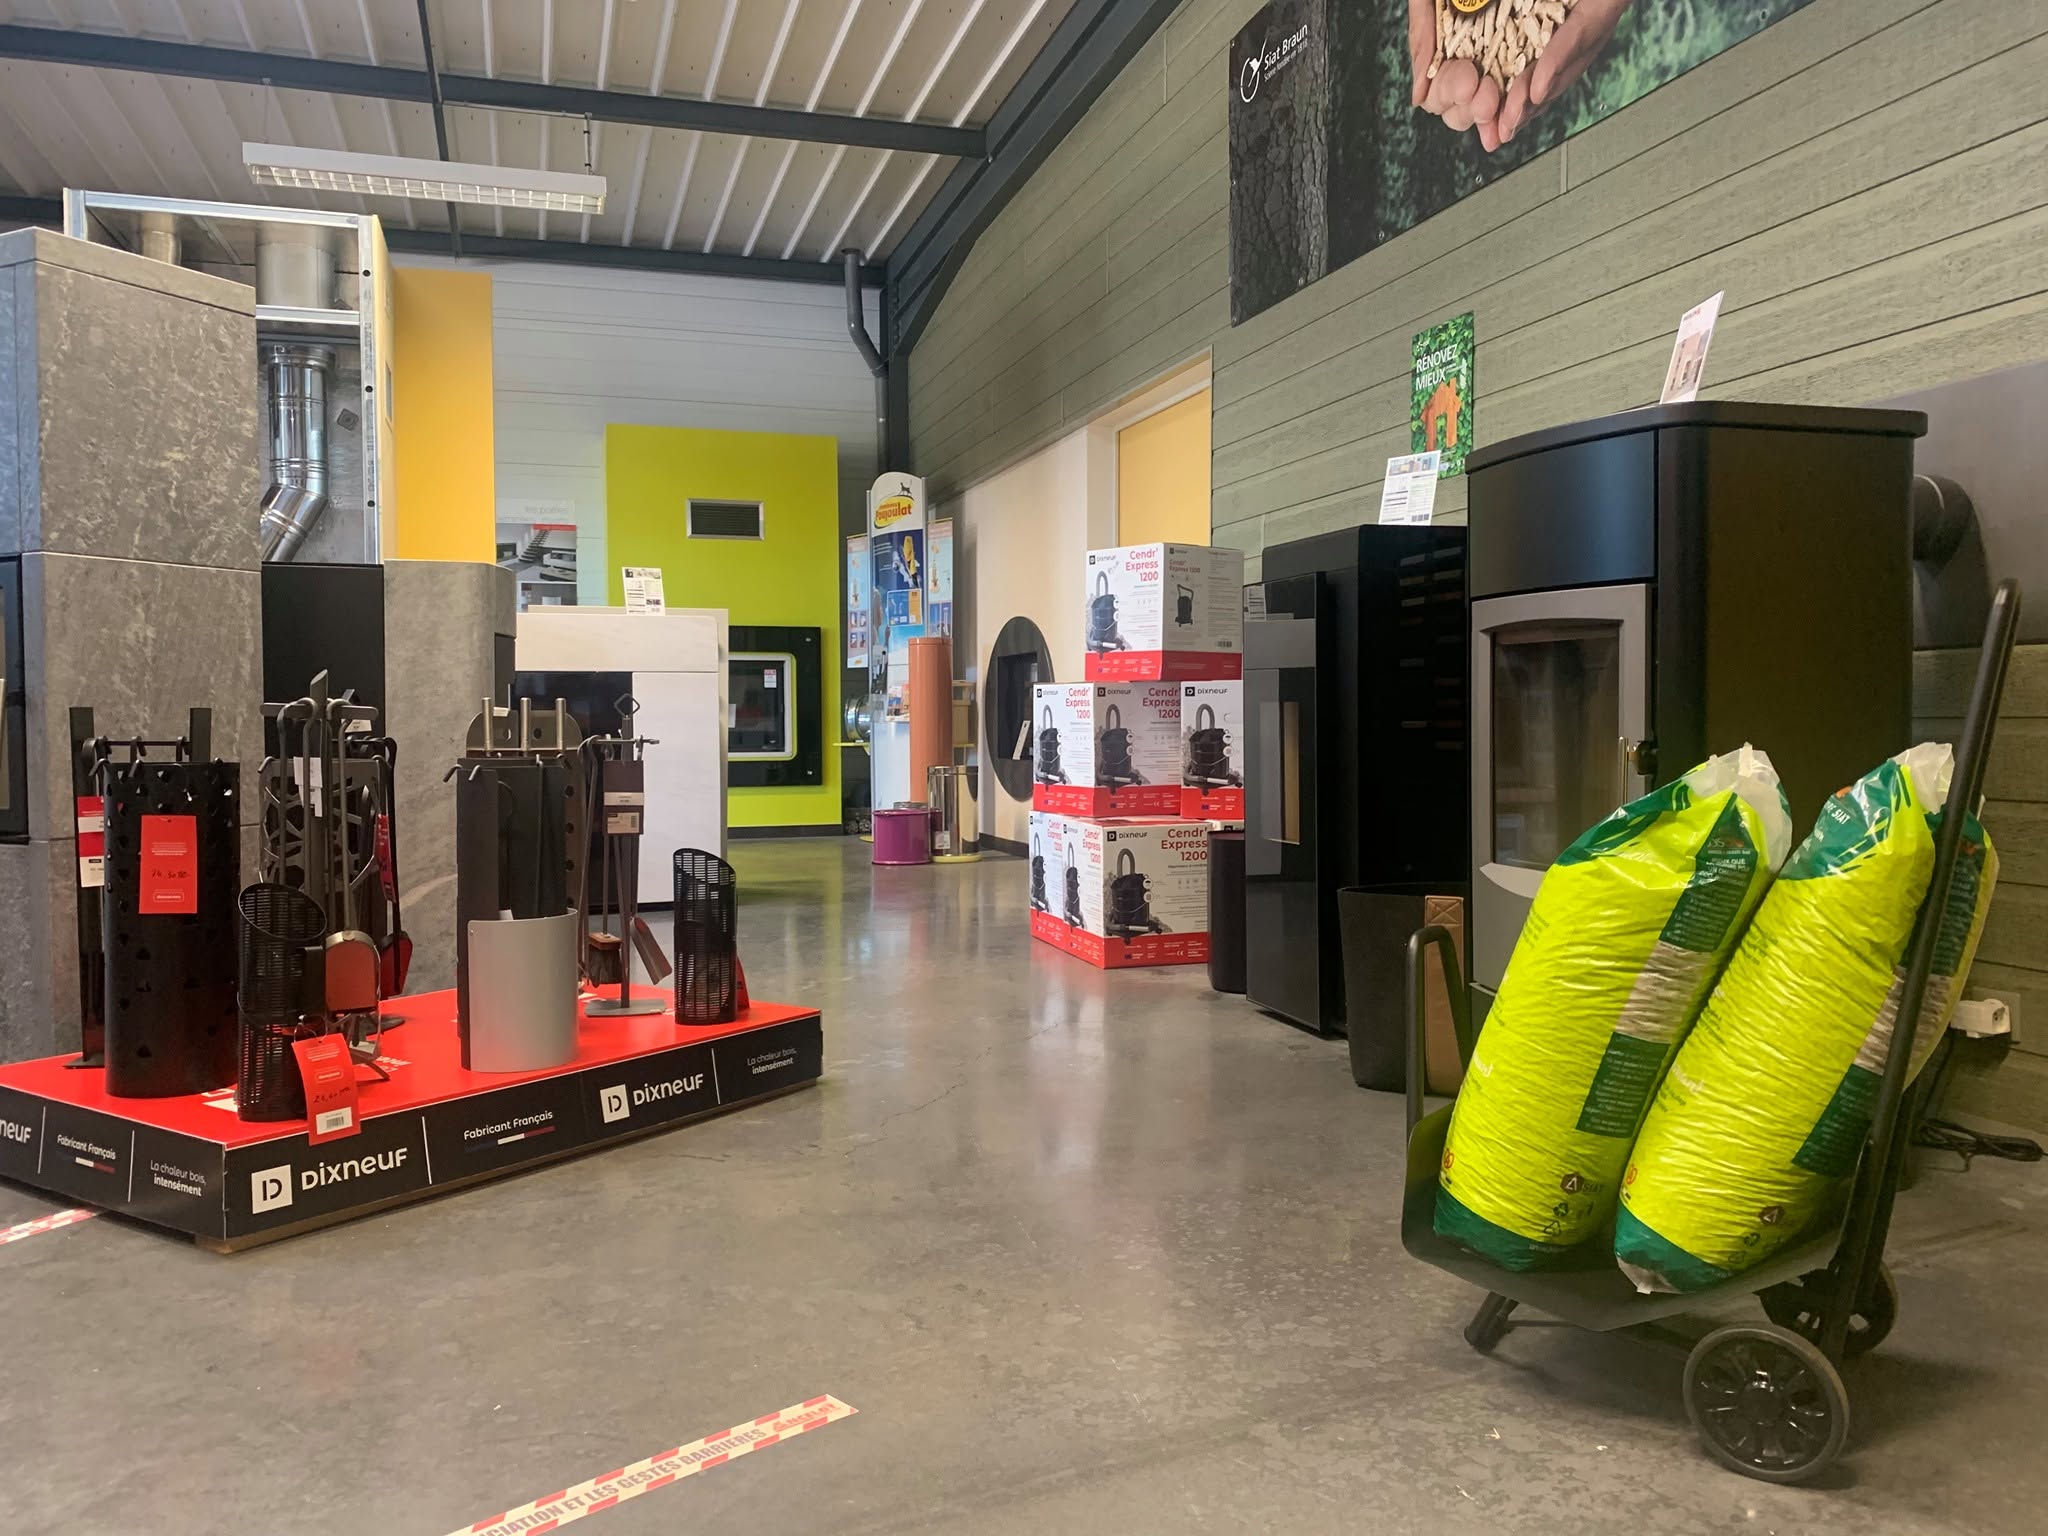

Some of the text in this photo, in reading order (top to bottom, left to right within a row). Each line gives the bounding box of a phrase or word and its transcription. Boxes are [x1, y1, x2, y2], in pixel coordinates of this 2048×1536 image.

[1264, 24, 1308, 70] Siat Braun
[1416, 344, 1458, 374] RÉNOVEZ
[1416, 367, 1446, 391] MIEUX
[1125, 561, 1159, 572] Express
[1139, 571, 1158, 582] 1200
[1065, 698, 1091, 708] Express
[1142, 698, 1181, 709] Express
[1076, 709, 1091, 719] 1200
[1158, 710, 1181, 719] 1200
[1831, 808, 1851, 825] SIAT
[1161, 840, 1208, 851] Express
[1181, 850, 1208, 861] 1200
[747, 1058, 756, 1066] La
[756, 1051, 781, 1063] chaleur
[752, 1057, 794, 1075] intensément
[463, 1110, 553, 1140] Fabricant Français
[57, 1134, 116, 1160] Fabricant Français
[150, 1160, 160, 1172] La
[160, 1162, 188, 1179] chaleur
[153, 1173, 202, 1197] intensément
[479, 1504, 564, 1536] CIATION
[562, 1496, 586, 1511] ET
[584, 1484, 619, 1502] LES
[617, 1460, 683, 1489] GESTES
[682, 1428, 767, 1466] BARRIERES
